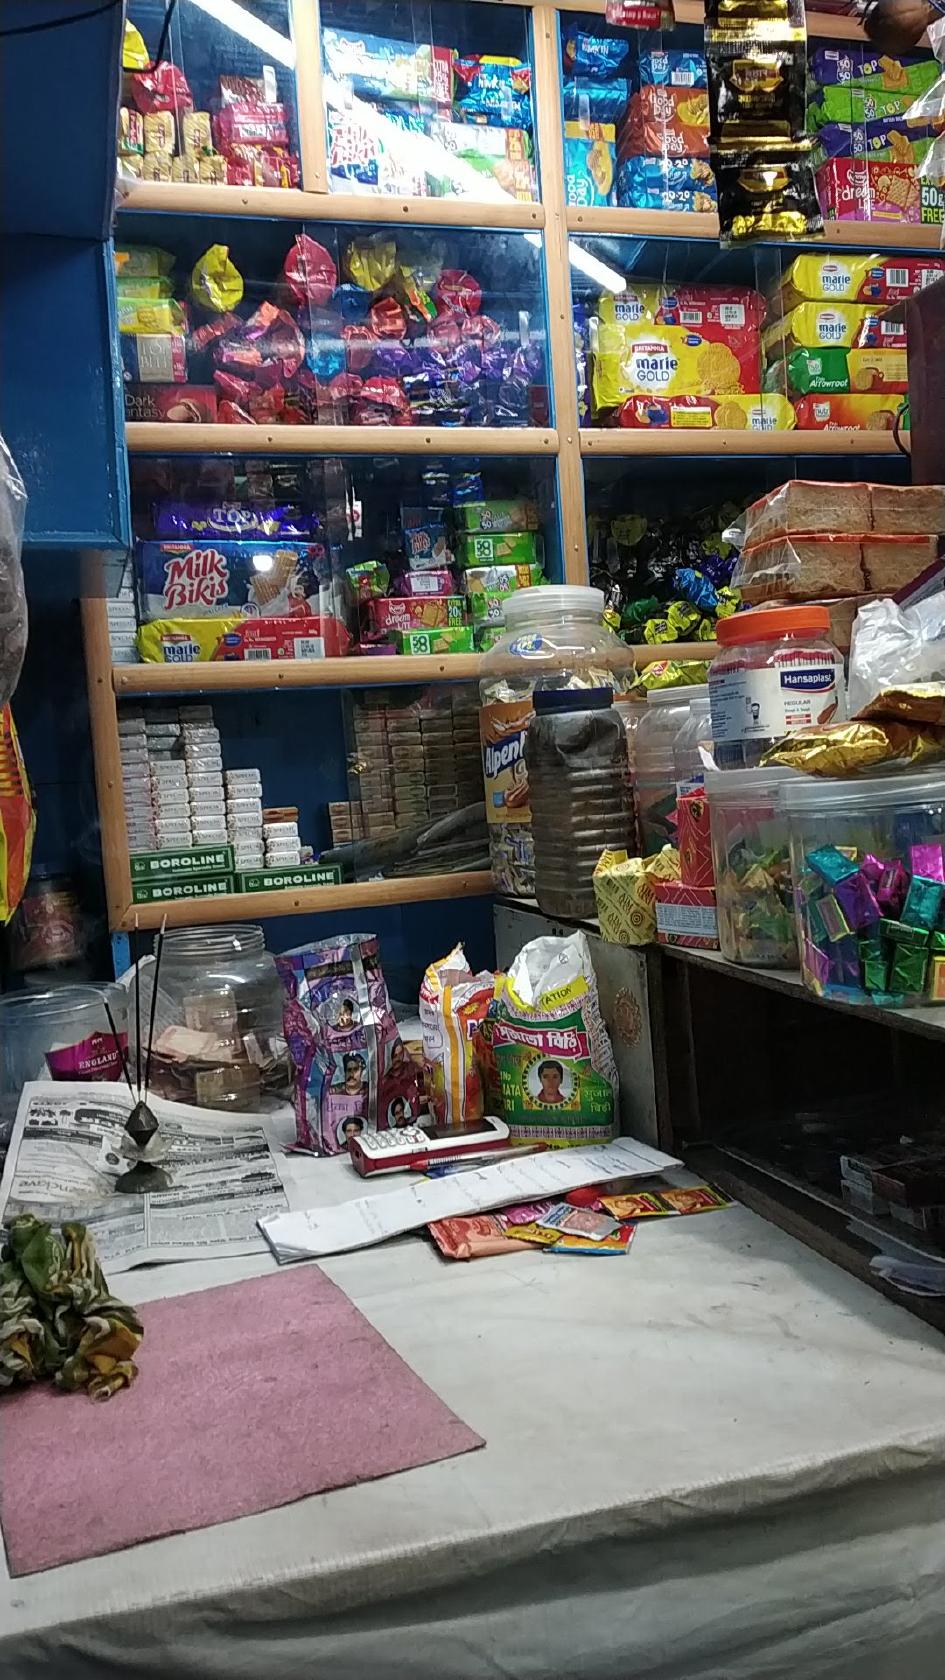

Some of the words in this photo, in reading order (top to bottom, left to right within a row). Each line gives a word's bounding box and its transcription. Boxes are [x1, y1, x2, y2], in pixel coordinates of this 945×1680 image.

[859, 60, 877, 74] TOP
[882, 101, 900, 114] TOP
[867, 134, 886, 150] TOP
[841, 184, 876, 201] dream
[921, 207, 945, 223] FREE
[822, 273, 850, 284] marie
[822, 283, 844, 292] GOLD
[614, 303, 645, 314] marie
[615, 313, 640, 321] GOLD
[818, 323, 847, 334] marie
[818, 331, 843, 340] GOLD
[636, 356, 679, 371] marie
[636, 370, 670, 382] GOLD
[809, 378, 848, 391] Arrowroot
[124, 393, 156, 408] Dark
[166, 550, 228, 585] Milk
[164, 575, 227, 610] Bikis
[385, 612, 411, 625] dream
[163, 643, 200, 655] marie
[783, 672, 832, 684] Hansaplast
[485, 732, 527, 774] Alpenl
[150, 854, 226, 869] BOROLINE
[264, 872, 335, 887] BOROLINE
[152, 882, 228, 898] BOROLINE
[78, 1052, 117, 1069] ENGLAND
